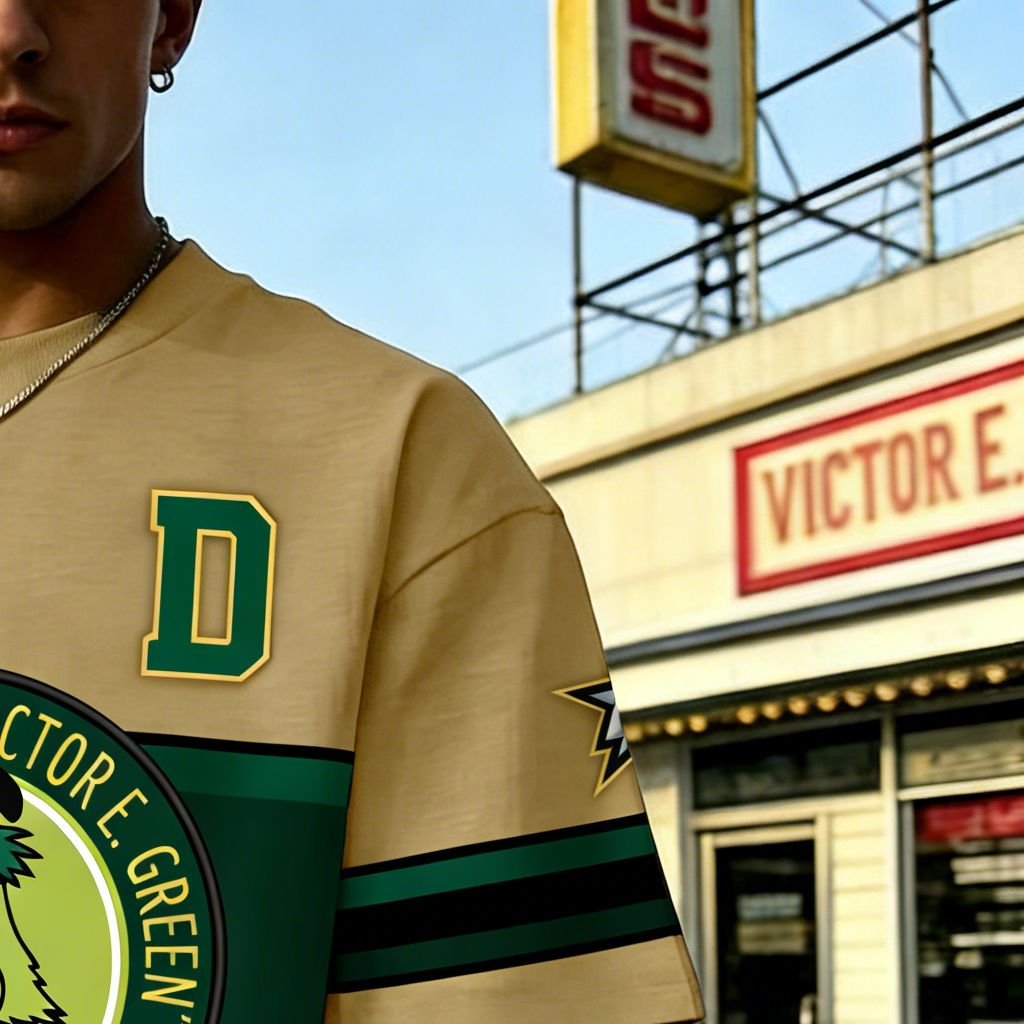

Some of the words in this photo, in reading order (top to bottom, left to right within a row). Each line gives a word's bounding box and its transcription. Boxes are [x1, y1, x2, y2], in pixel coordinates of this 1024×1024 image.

[762, 421, 962, 545] VICTOR
[973, 402, 1024, 494] E.
[140, 488, 277, 682] D
[96, 787, 149, 849] E.
